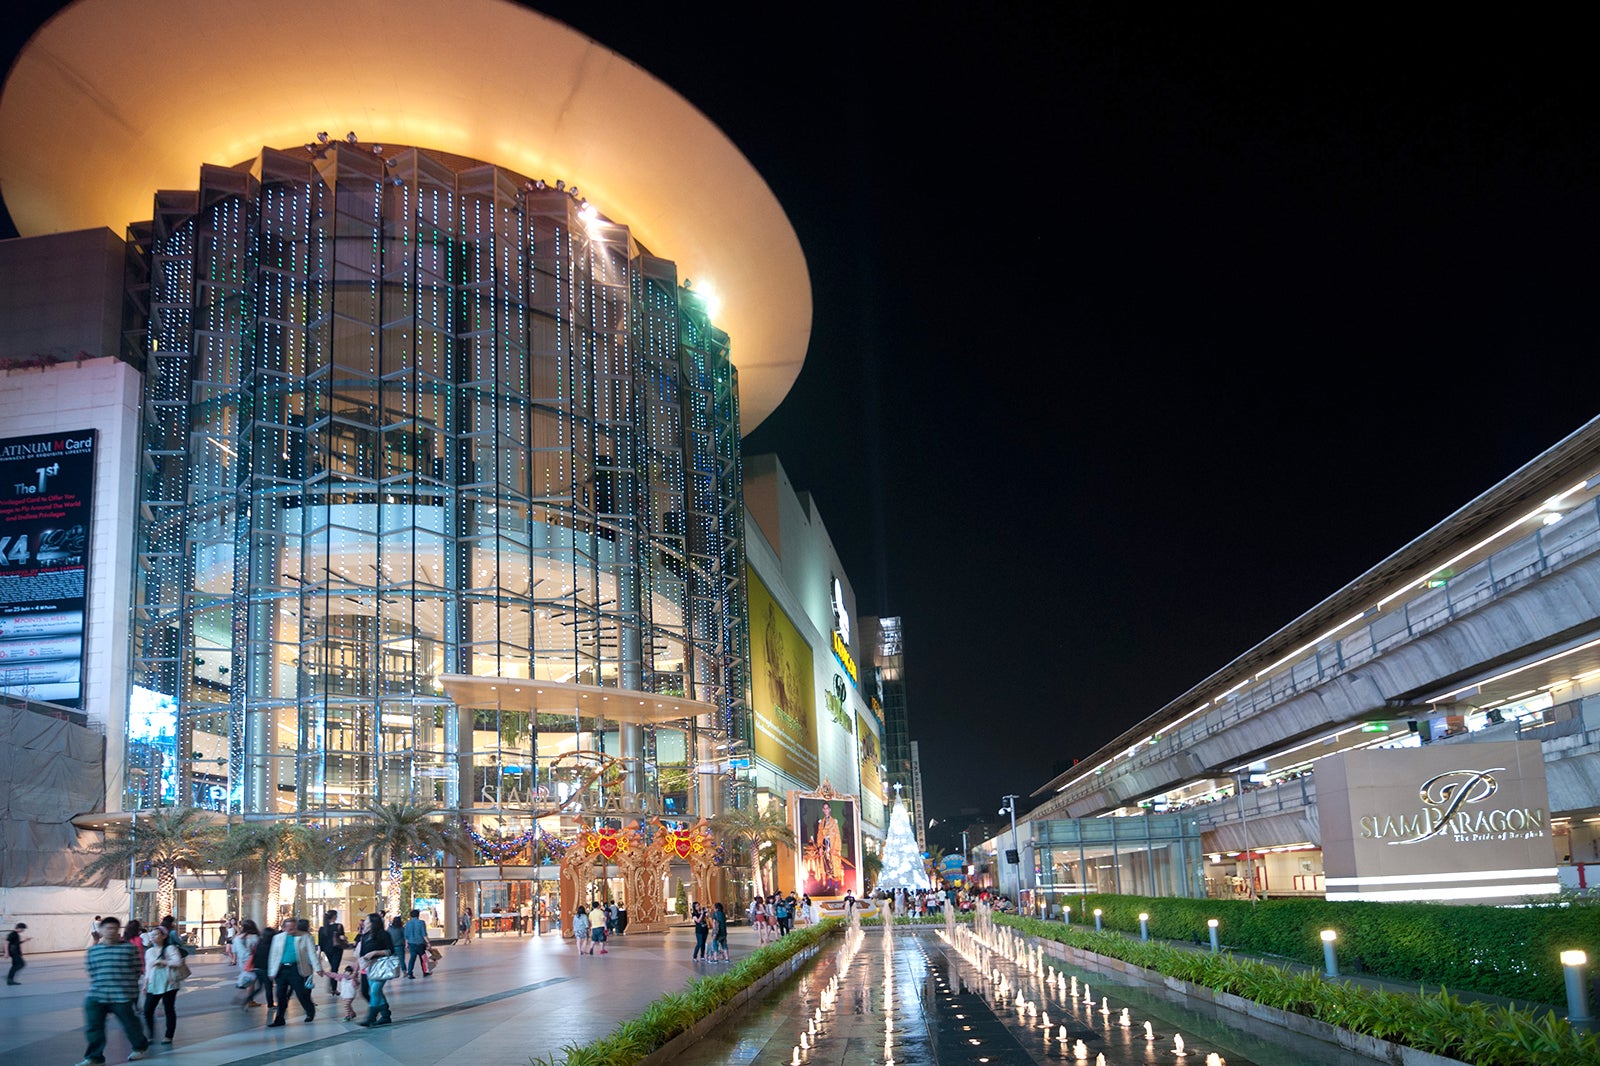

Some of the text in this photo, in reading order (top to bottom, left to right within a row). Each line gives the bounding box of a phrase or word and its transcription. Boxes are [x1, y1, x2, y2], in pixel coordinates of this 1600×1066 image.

[0, 442, 52, 456] ATINUM
[14, 483, 36, 494] The
[1453, 834, 1469, 842] The
[1472, 832, 1494, 841] Pride
[1497, 831, 1507, 841] of
